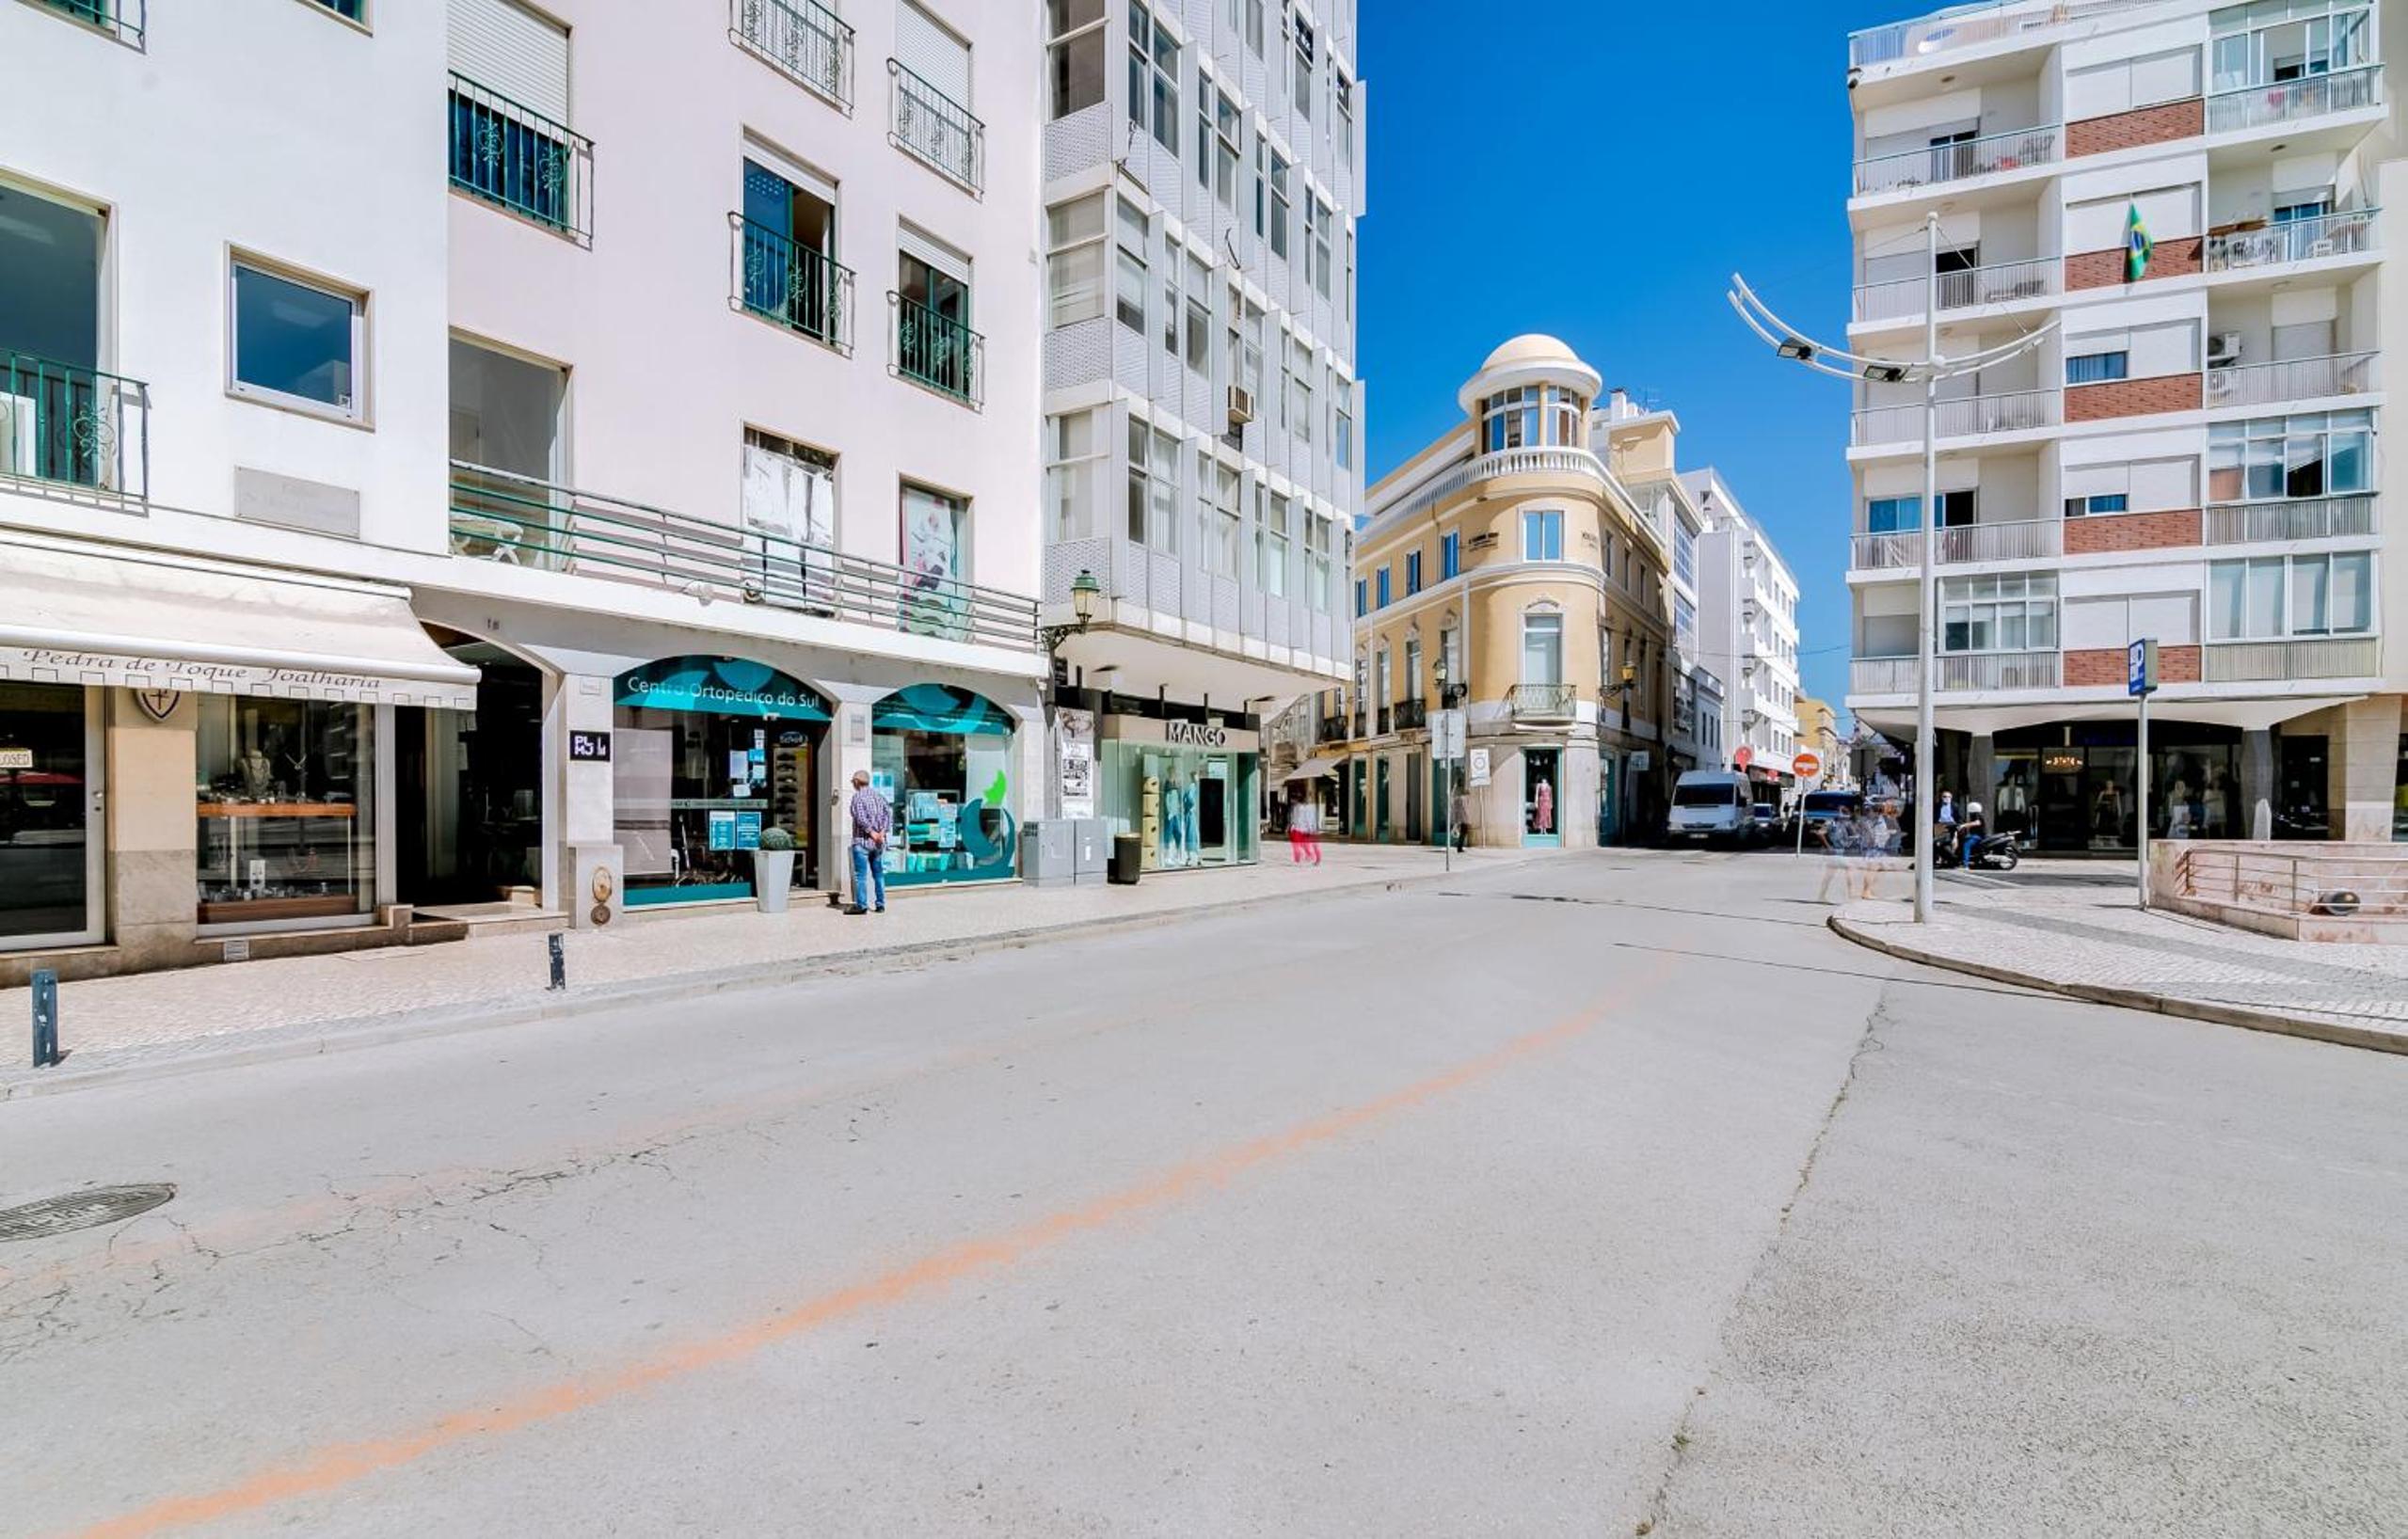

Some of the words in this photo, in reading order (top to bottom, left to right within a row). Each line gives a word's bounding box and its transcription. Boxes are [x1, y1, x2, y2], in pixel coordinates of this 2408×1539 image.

[24, 650, 114, 668] Pedra
[126, 658, 155, 672] de
[166, 662, 247, 681] Toque
[262, 667, 380, 688] Joalharia
[628, 676, 684, 695] Centro
[778, 690, 795, 706] do
[799, 693, 820, 708] Sul
[1166, 722, 1226, 746] MANGO
